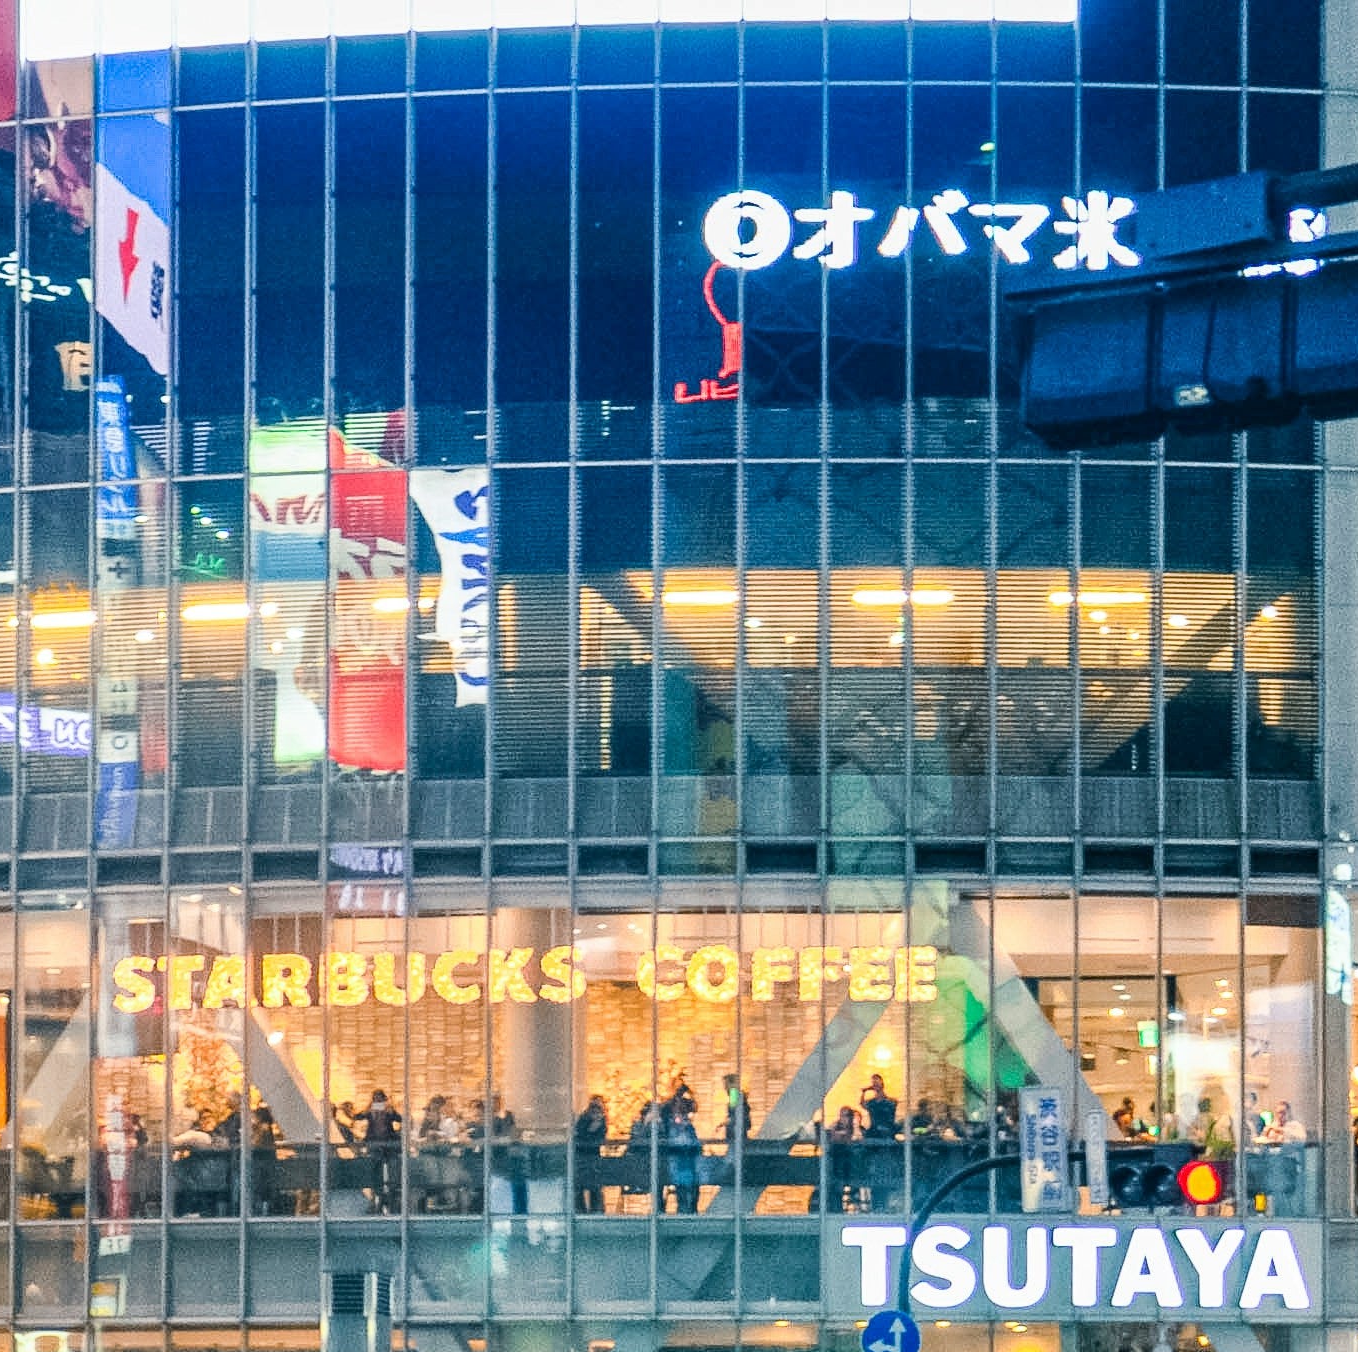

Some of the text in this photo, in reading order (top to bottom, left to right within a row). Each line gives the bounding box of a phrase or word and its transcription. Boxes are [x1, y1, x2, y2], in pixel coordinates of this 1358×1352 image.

[111, 944, 939, 1014] STARBUCKS COFFEE
[841, 1225, 1311, 1310] TSUTAYA
